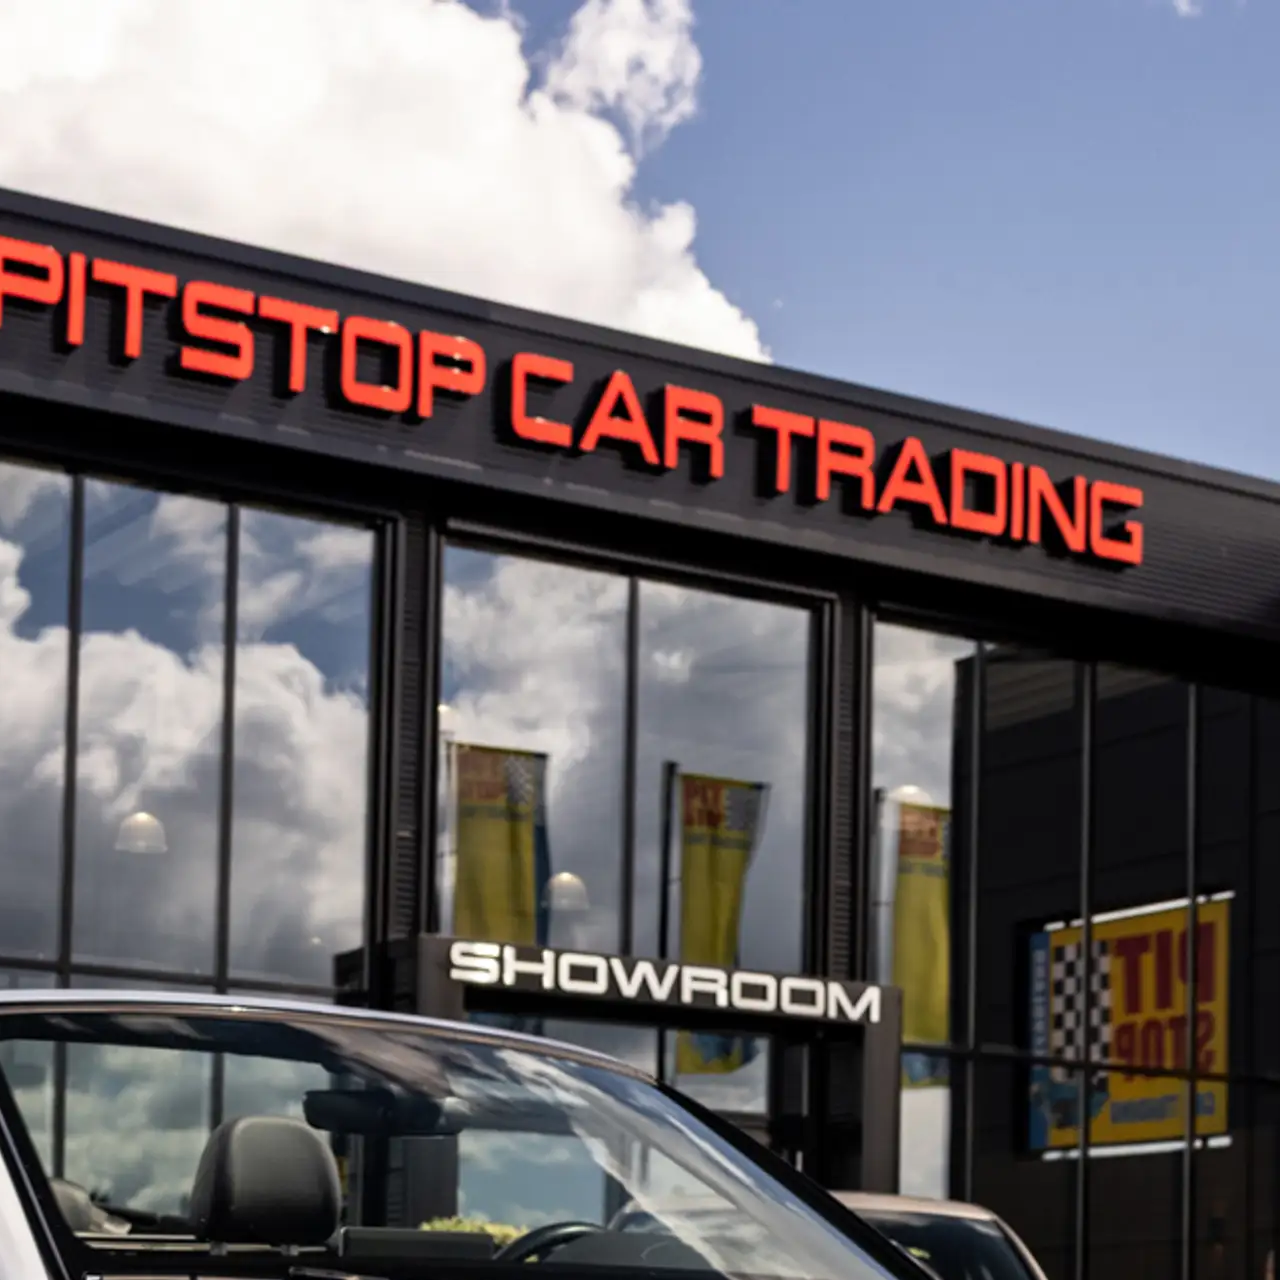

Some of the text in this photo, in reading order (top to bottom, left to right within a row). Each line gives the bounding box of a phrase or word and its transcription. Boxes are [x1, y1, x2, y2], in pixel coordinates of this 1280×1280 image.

[510, 351, 725, 478] CAR
[751, 403, 1145, 565] TRADING
[449, 940, 882, 1024] SHOWROOM
